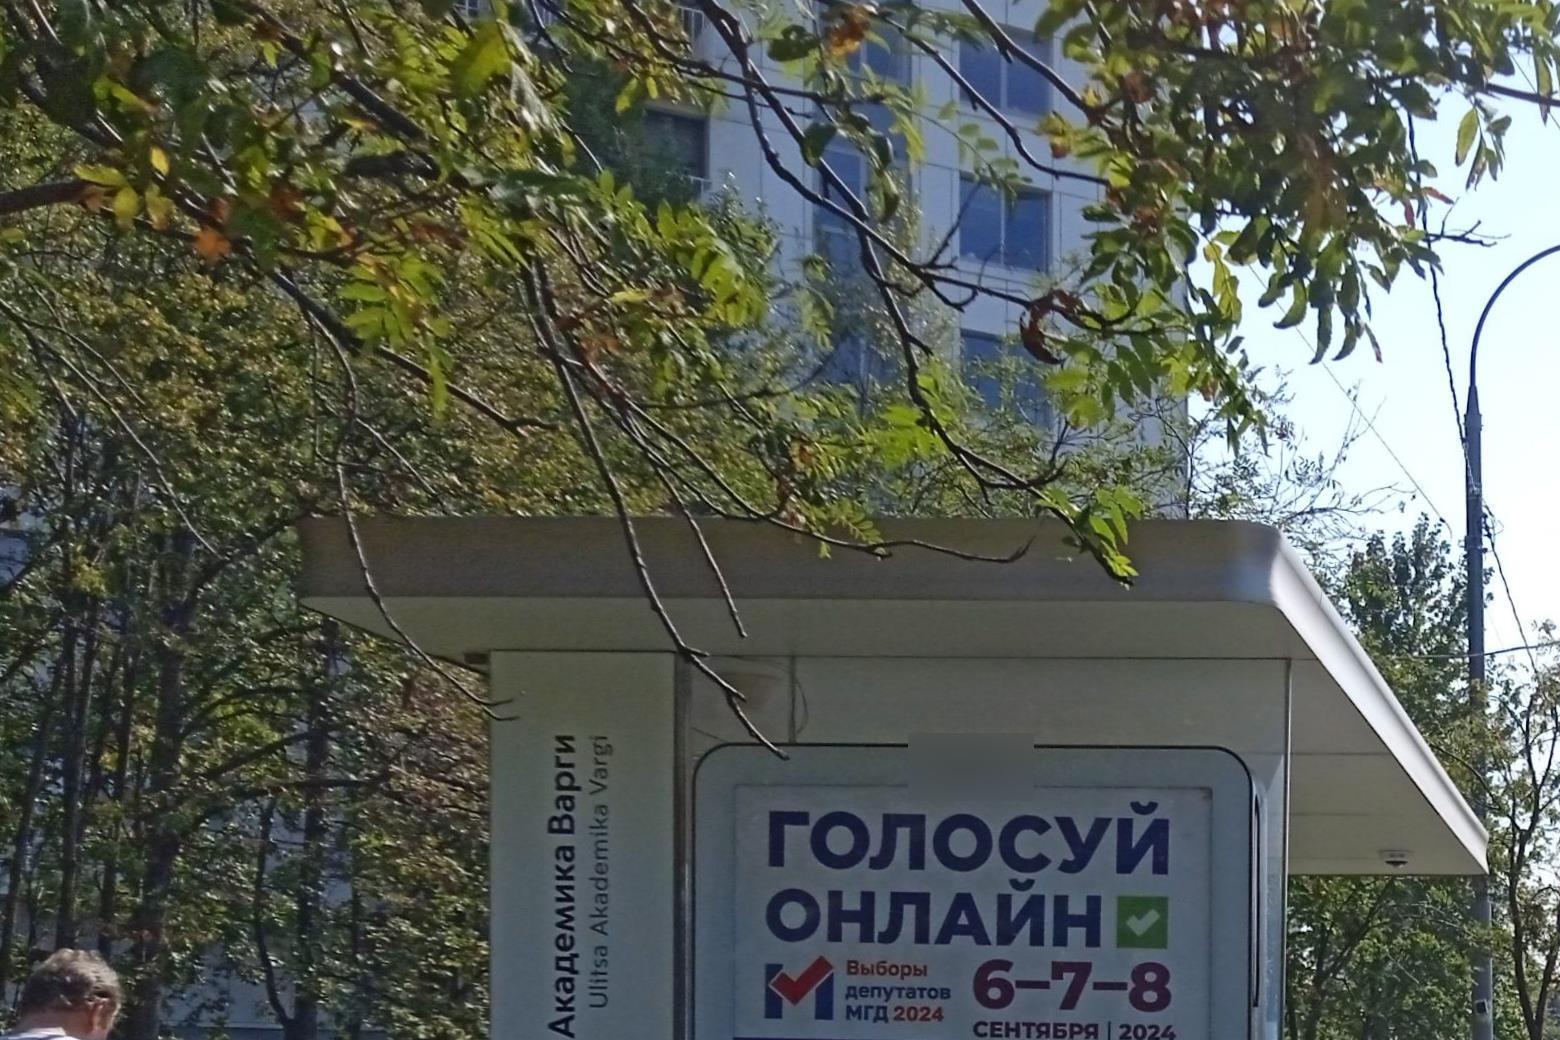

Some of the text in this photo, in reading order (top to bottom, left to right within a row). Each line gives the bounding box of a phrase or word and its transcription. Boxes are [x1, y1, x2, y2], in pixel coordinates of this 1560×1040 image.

[548, 735, 582, 835] Варги
[589, 736, 613, 1008] Ulitsa Akademika Vargi
[768, 801, 1170, 875] ГОЛОСУЙ
[548, 844, 579, 1038] Академика
[765, 878, 1102, 947] ОНЛАЙН
[845, 985, 951, 1003] депутатов
[846, 960, 927, 978] Выборы
[846, 1005, 944, 1023] МГД 2024
[973, 1020, 1176, 1040] СЕНТЯБРЯ 2024
